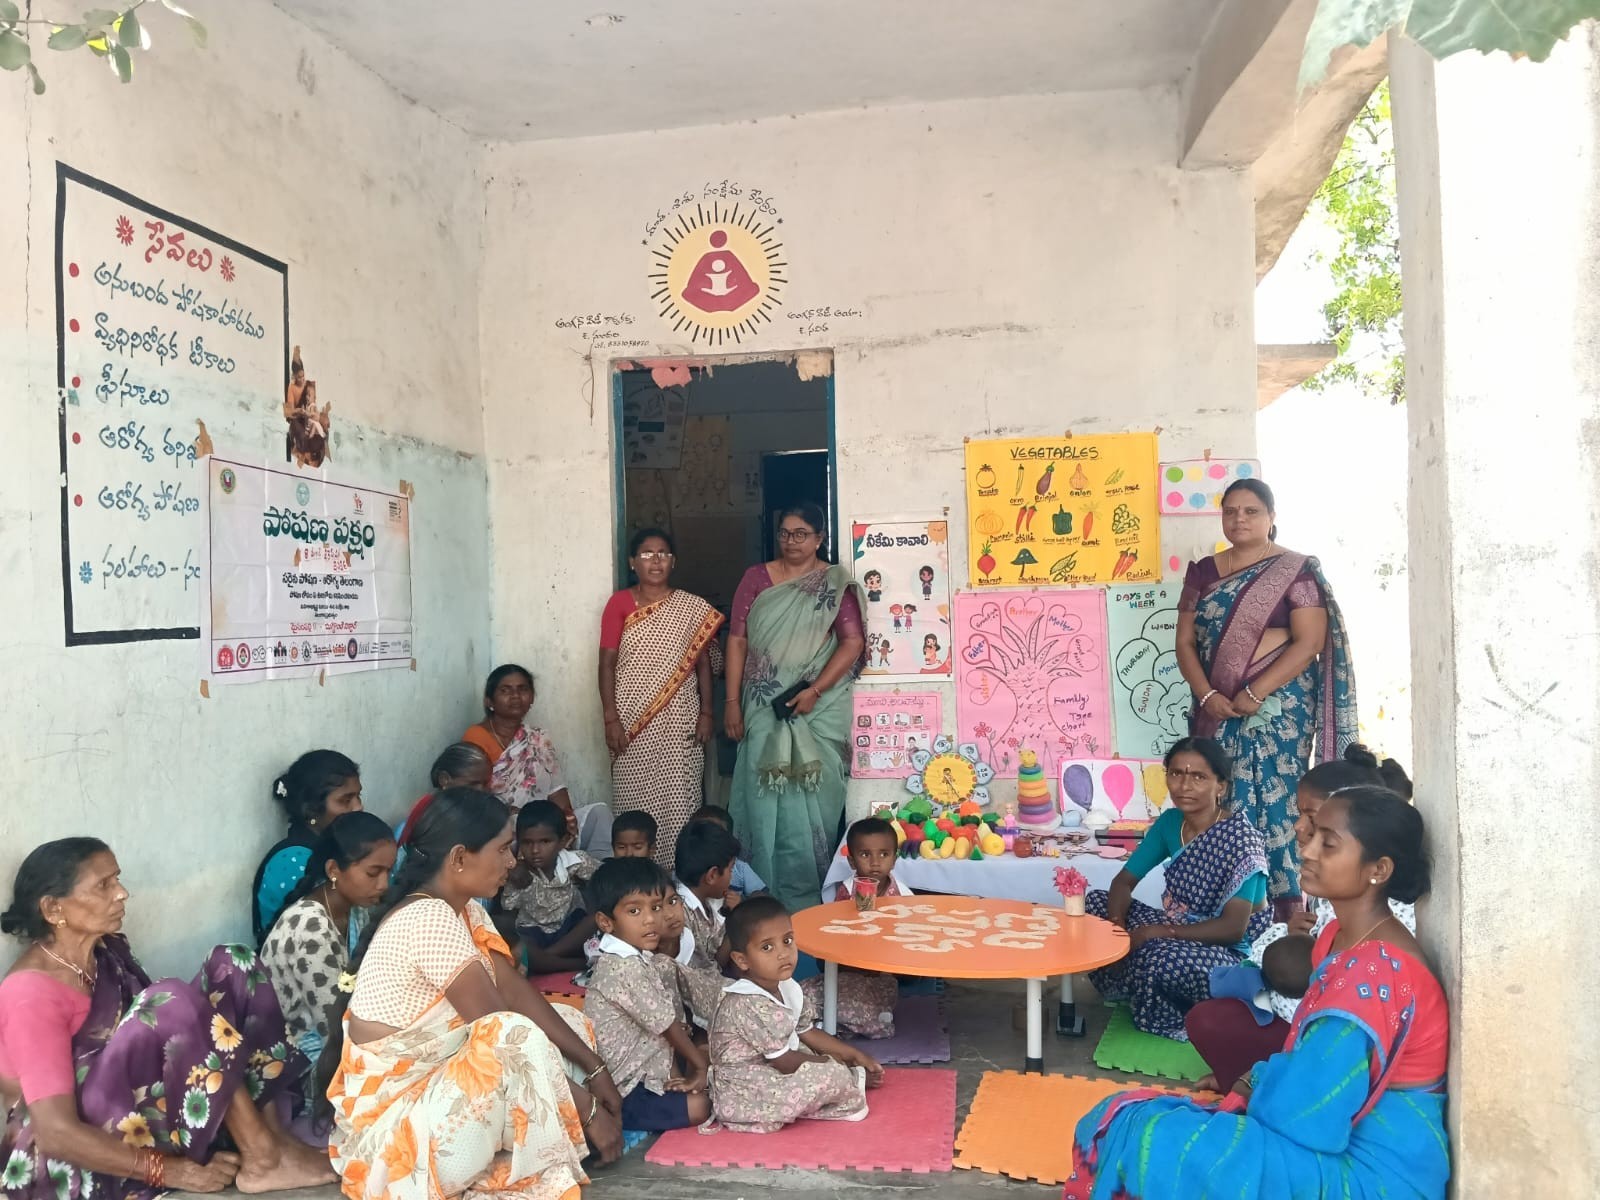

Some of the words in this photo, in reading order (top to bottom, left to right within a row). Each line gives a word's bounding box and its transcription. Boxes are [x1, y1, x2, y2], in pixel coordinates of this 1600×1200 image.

[144, 221, 212, 272] సేవలు
[94, 312, 178, 366] వ్యాధినిరోధక
[189, 336, 235, 373] టీకాలు
[99, 420, 155, 463] ఆరోగ్య
[1010, 446, 1098, 459] VEGETABLES
[98, 481, 151, 521] ఆరోగ్య
[263, 506, 329, 544] పోషణ
[334, 517, 375, 560] పక్షం
[866, 532, 894, 548] నీకేమి
[896, 534, 928, 546] కావాలి
[1116, 592, 1141, 601] DAYS
[1160, 590, 1167, 598] A
[1129, 599, 1155, 608] WEEK
[1121, 645, 1151, 676] THURSDAY
[1138, 683, 1154, 713] SUNDAY
